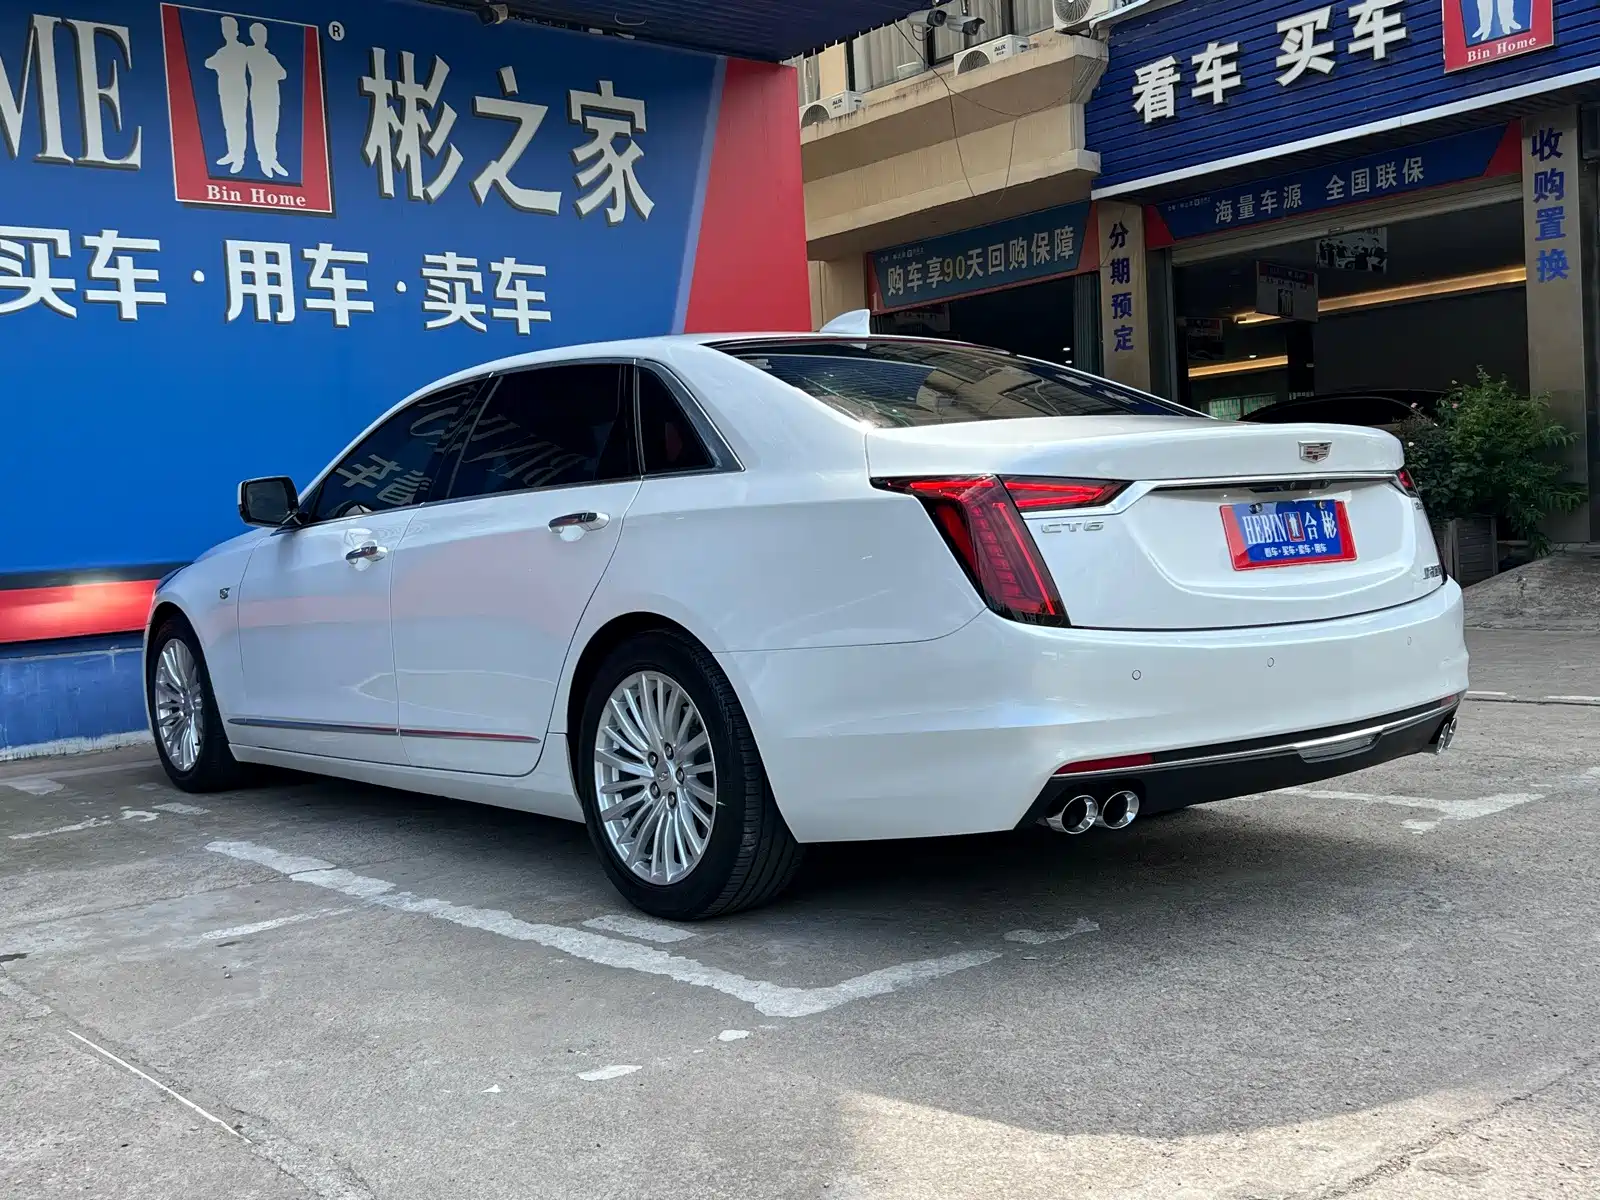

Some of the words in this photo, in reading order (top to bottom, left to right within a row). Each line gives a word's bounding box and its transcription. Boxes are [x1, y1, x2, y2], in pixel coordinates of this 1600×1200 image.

[1132, 41, 1242, 124] 看车
[1275, 0, 1407, 87] 买车
[1467, 45, 1490, 63] Bin
[1496, 35, 1537, 54] Home
[360, 47, 656, 225] 彬之家
[206, 184, 242, 202] Bin
[249, 187, 306, 207] Home
[1215, 183, 1302, 224] 海量车源
[1325, 156, 1425, 201] 全国联保
[1531, 127, 1570, 283] 收购置换
[887, 224, 1074, 297] 购车享90天回购保障
[1109, 220, 1134, 352] 分期预定
[1041, 521, 1104, 533] CT6
[1242, 513, 1288, 544] HEBIN
[1304, 510, 1338, 540] 合彬
